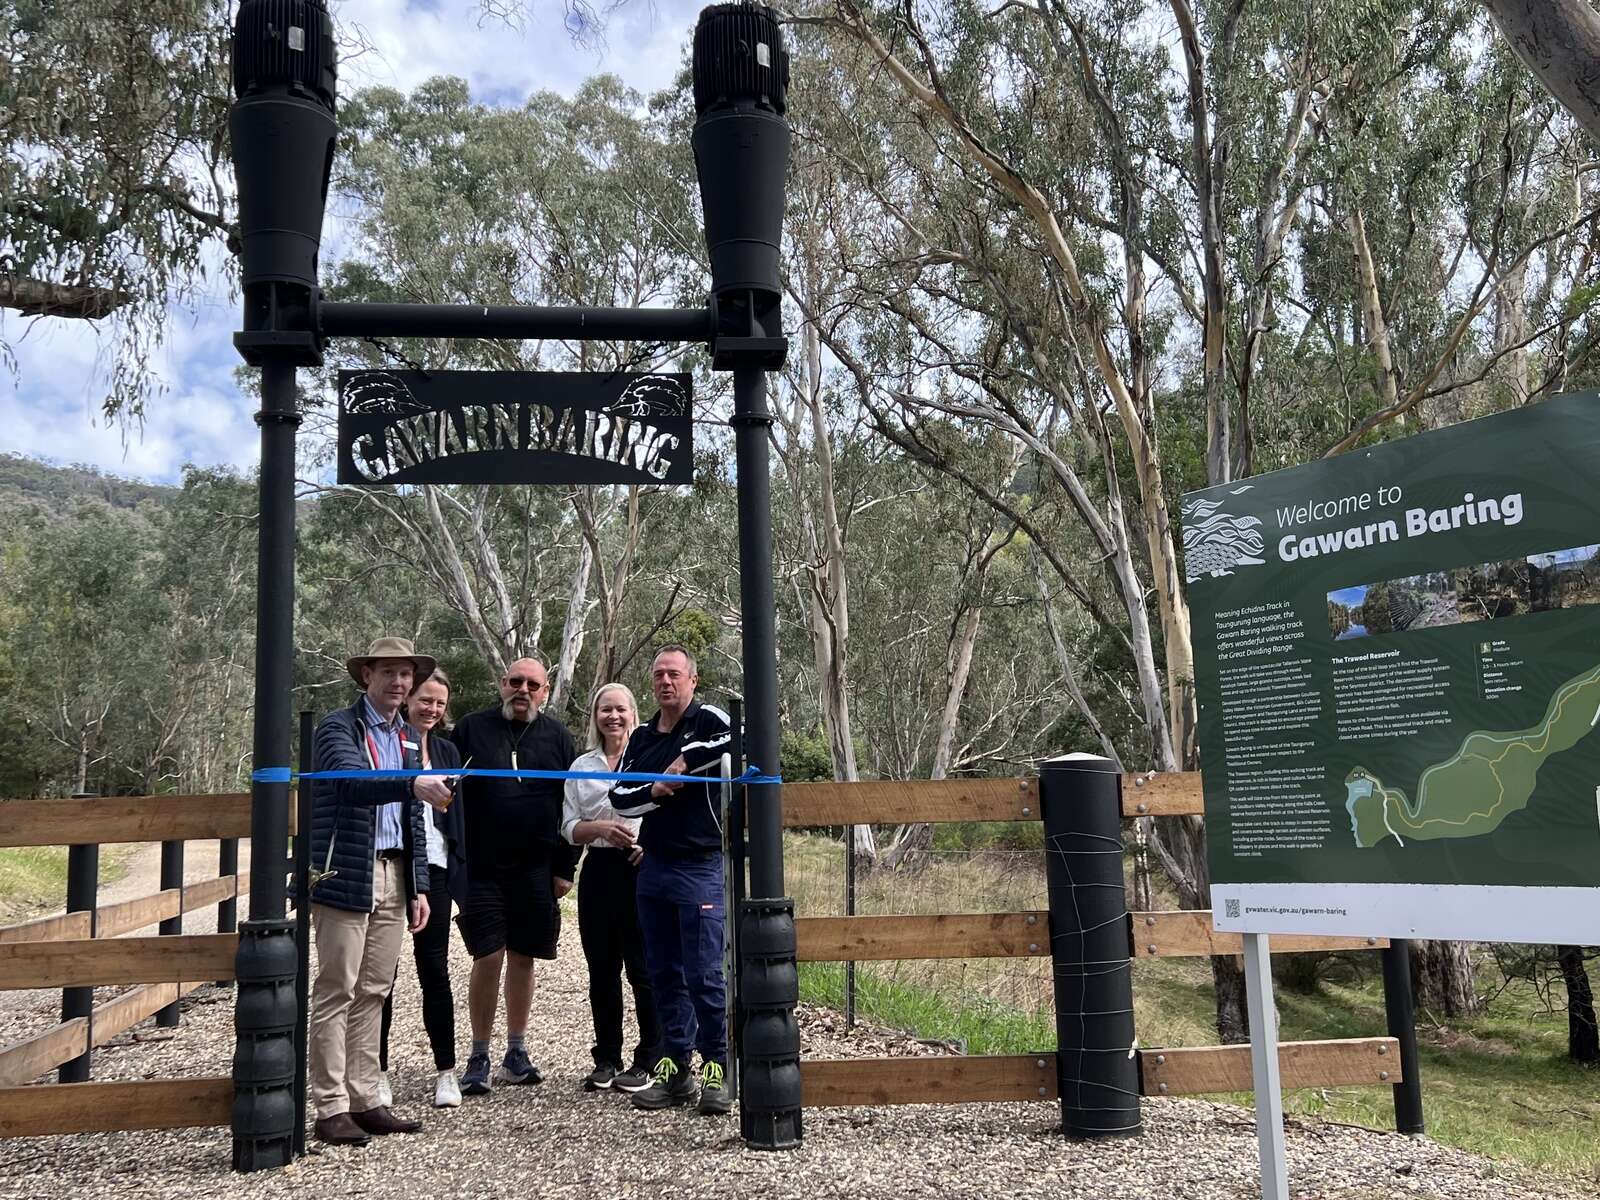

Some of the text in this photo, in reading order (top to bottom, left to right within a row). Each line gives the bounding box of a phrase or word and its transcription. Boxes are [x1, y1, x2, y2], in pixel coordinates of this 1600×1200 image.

[352, 403, 679, 480] GAWARN BARING
[1276, 486, 1402, 529] Welcome to
[1278, 493, 1523, 562] Gawarn Baring
[1215, 609, 1240, 618] Meaning
[1241, 606, 1265, 614] Echidna
[1266, 602, 1282, 610] Track
[1240, 628, 1260, 636] Baring
[1261, 624, 1285, 632] walking
[1287, 620, 1303, 628] track
[1217, 642, 1234, 651] offers
[1235, 637, 1264, 647] wonderful
[1247, 647, 1271, 656] Dividing
[1344, 654, 1369, 662] Trawool
[1370, 650, 1400, 659] Reservoir
